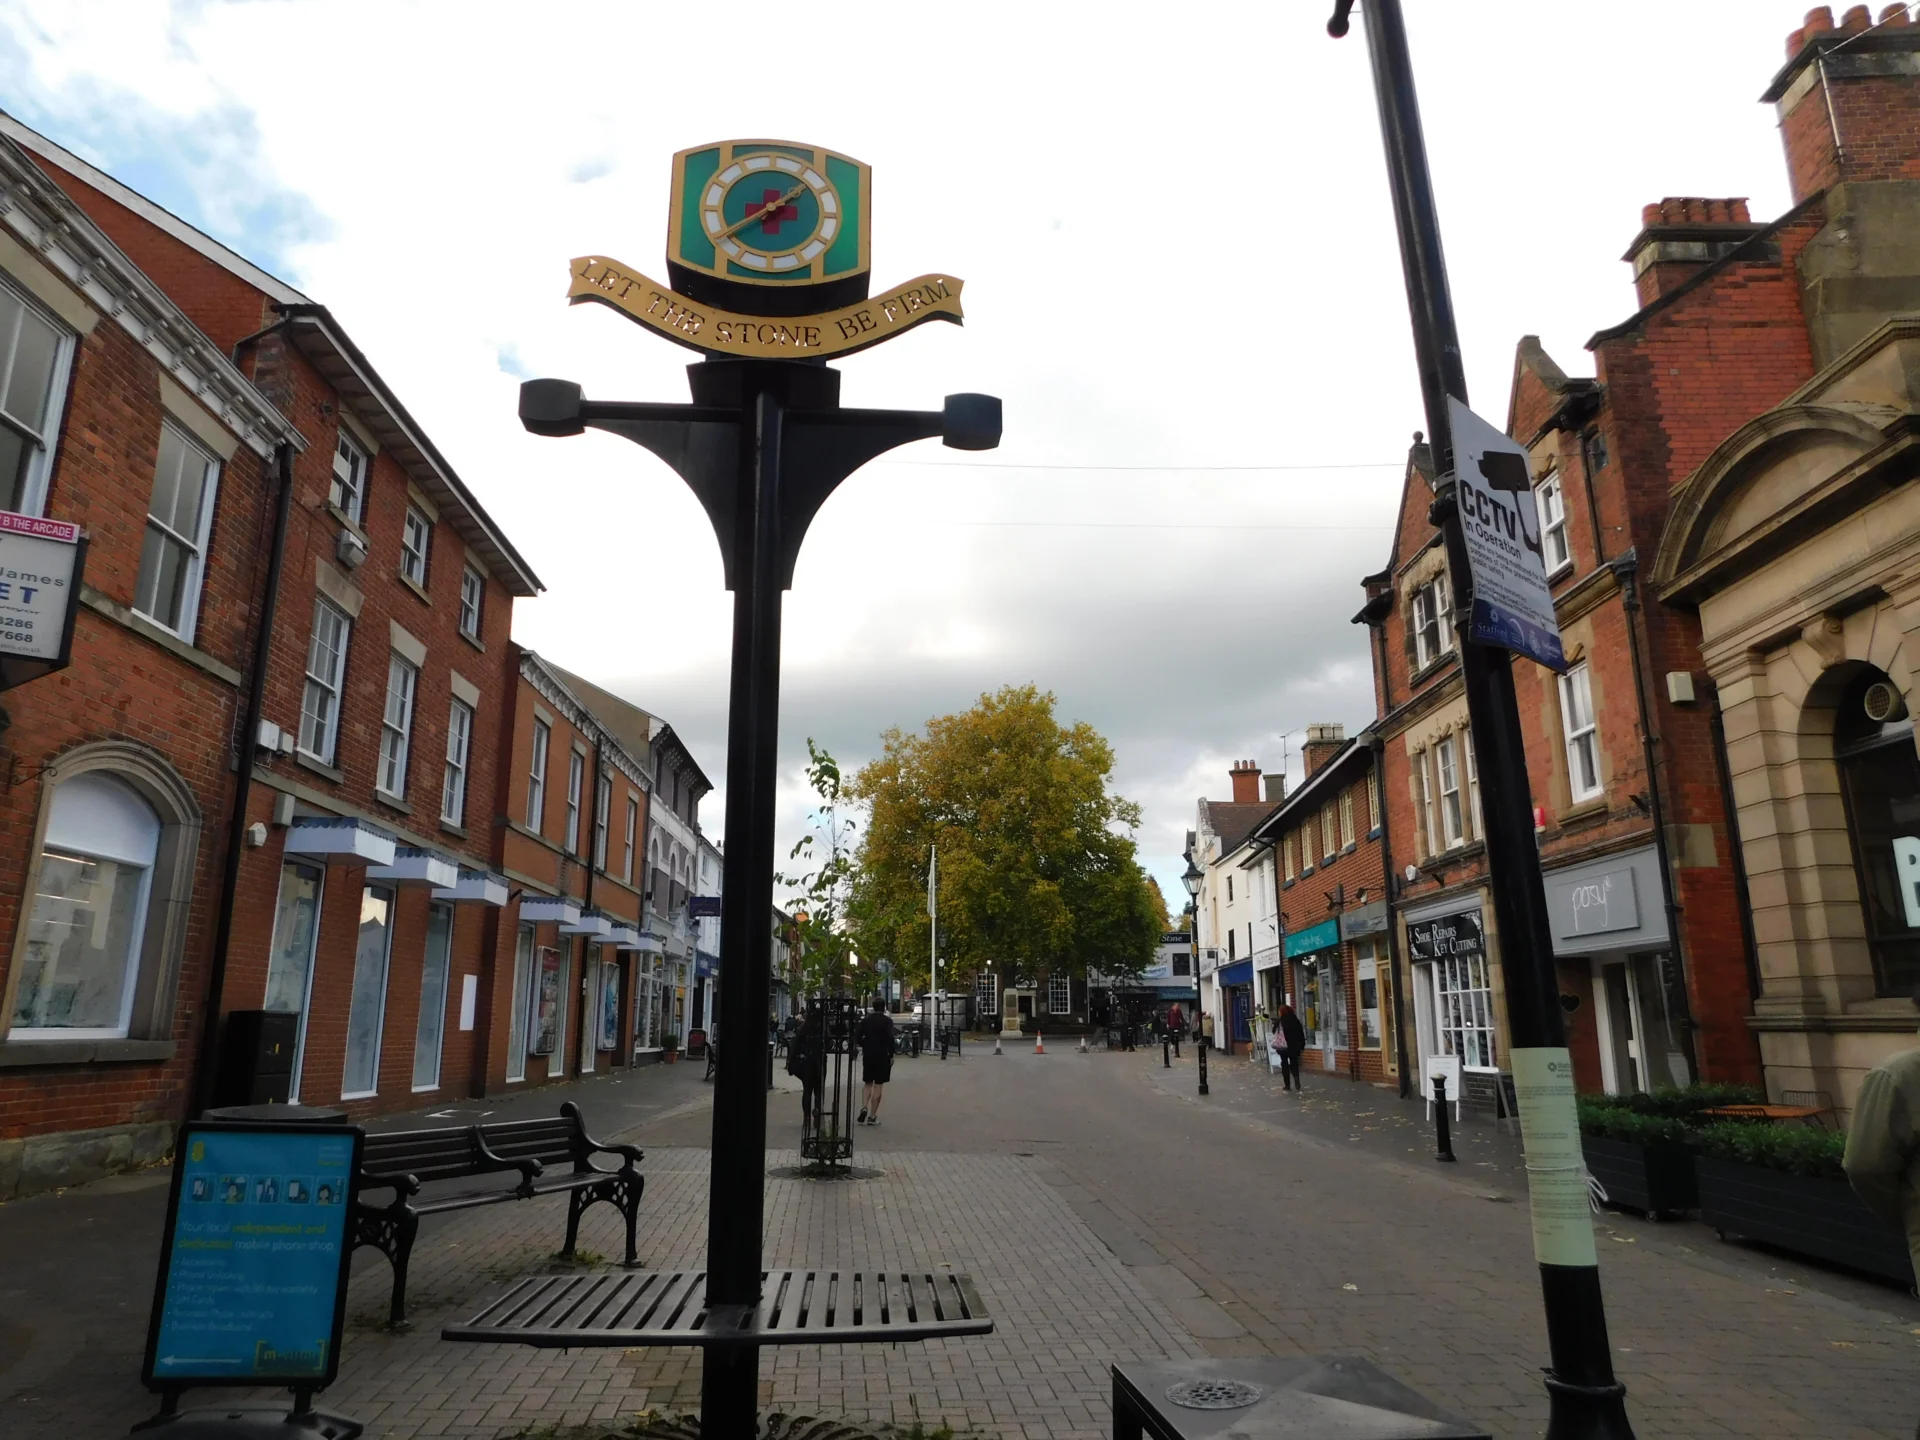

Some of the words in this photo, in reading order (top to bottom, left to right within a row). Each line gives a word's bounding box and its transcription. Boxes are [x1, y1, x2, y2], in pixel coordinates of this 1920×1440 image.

[578, 257, 642, 301] LET
[646, 290, 706, 336] THE
[715, 321, 822, 348] STONE
[834, 309, 878, 342] BE
[881, 276, 953, 323] FIRM
[1459, 479, 1516, 542] CCTV
[2, 517, 10, 526] B
[13, 517, 32, 531] THE
[32, 520, 72, 539] ARCADE
[1463, 514, 1475, 533] In
[1475, 522, 1522, 560] Operation
[1414, 926, 1431, 945] SHOE
[1431, 923, 1457, 942] REPAIRS
[1433, 939, 1448, 957] KEY
[1449, 936, 1477, 955] CUTTING
